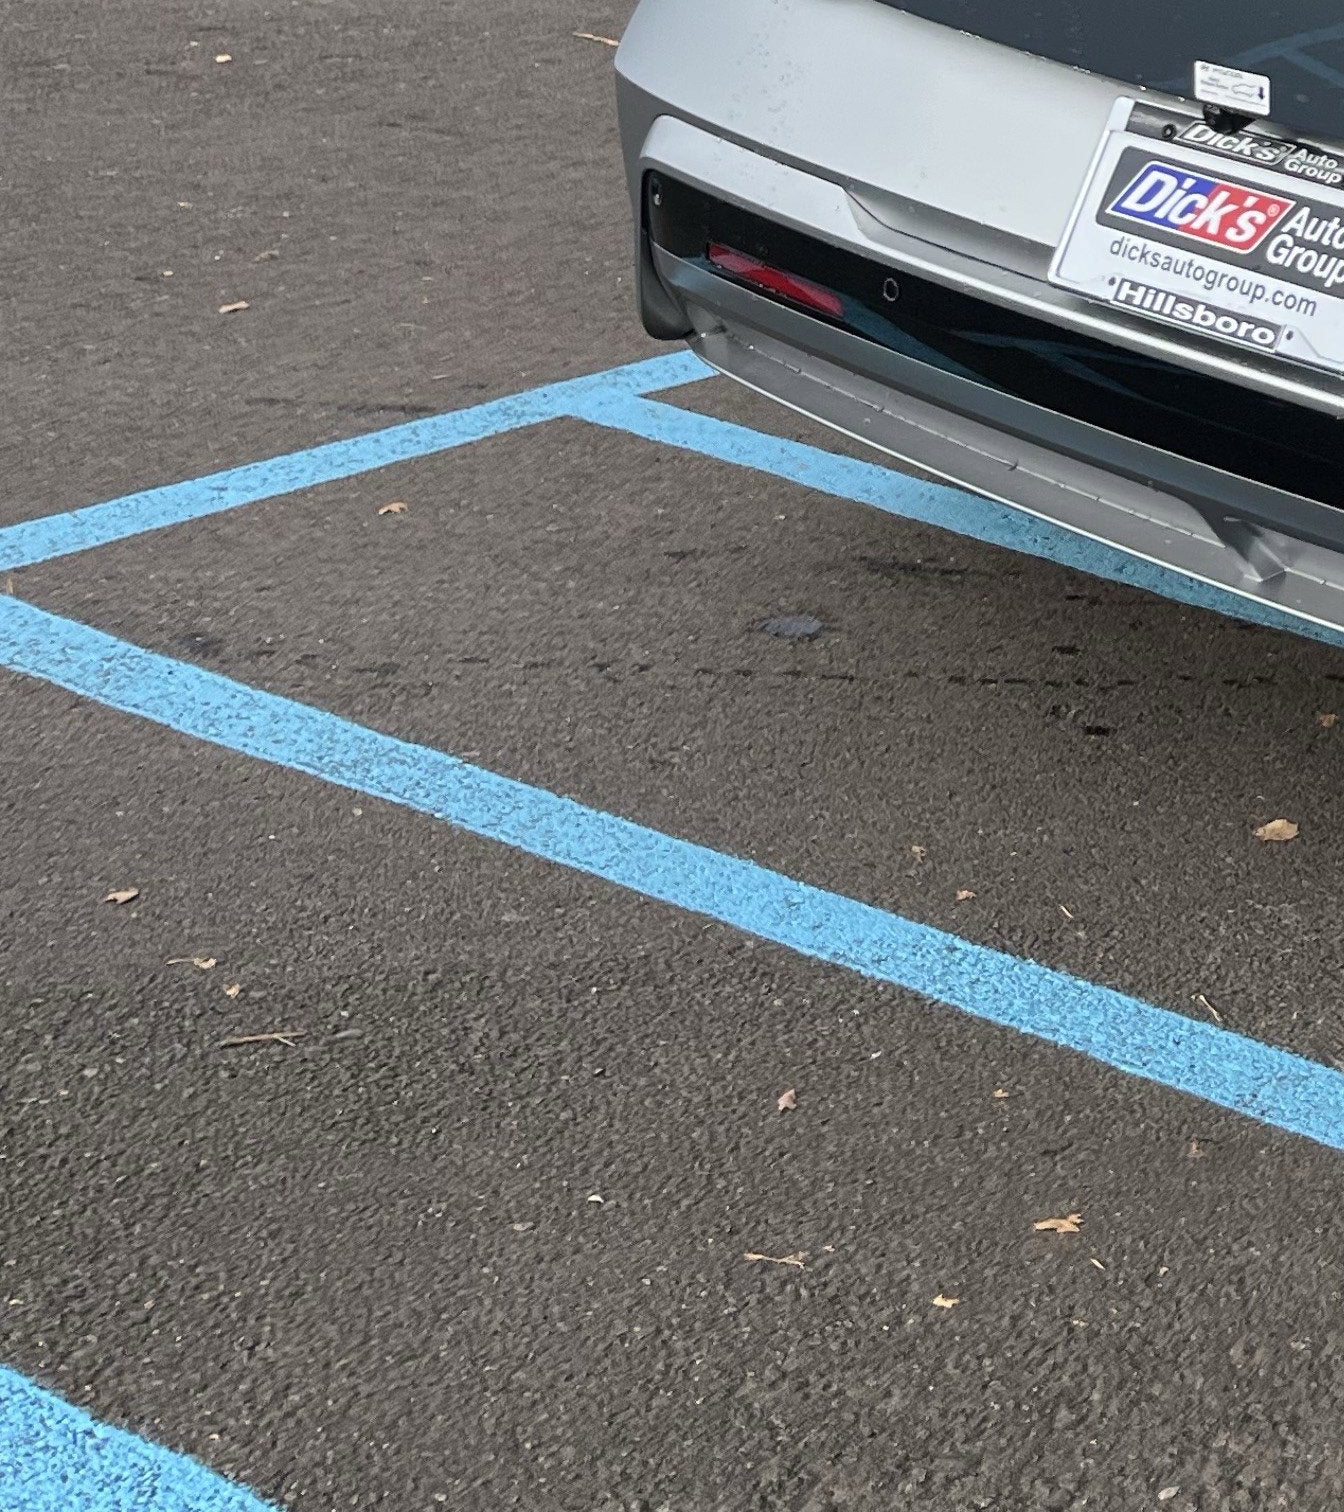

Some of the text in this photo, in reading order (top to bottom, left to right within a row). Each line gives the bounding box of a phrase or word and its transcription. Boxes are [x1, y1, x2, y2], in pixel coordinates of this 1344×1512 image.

[1185, 123, 1339, 169] Dick's Auto
[1283, 159, 1343, 185] Group
[1121, 170, 1268, 243] Dick's
[1109, 236, 1318, 317] dicksautogroup.com
[1116, 279, 1277, 344] Hillsboro
